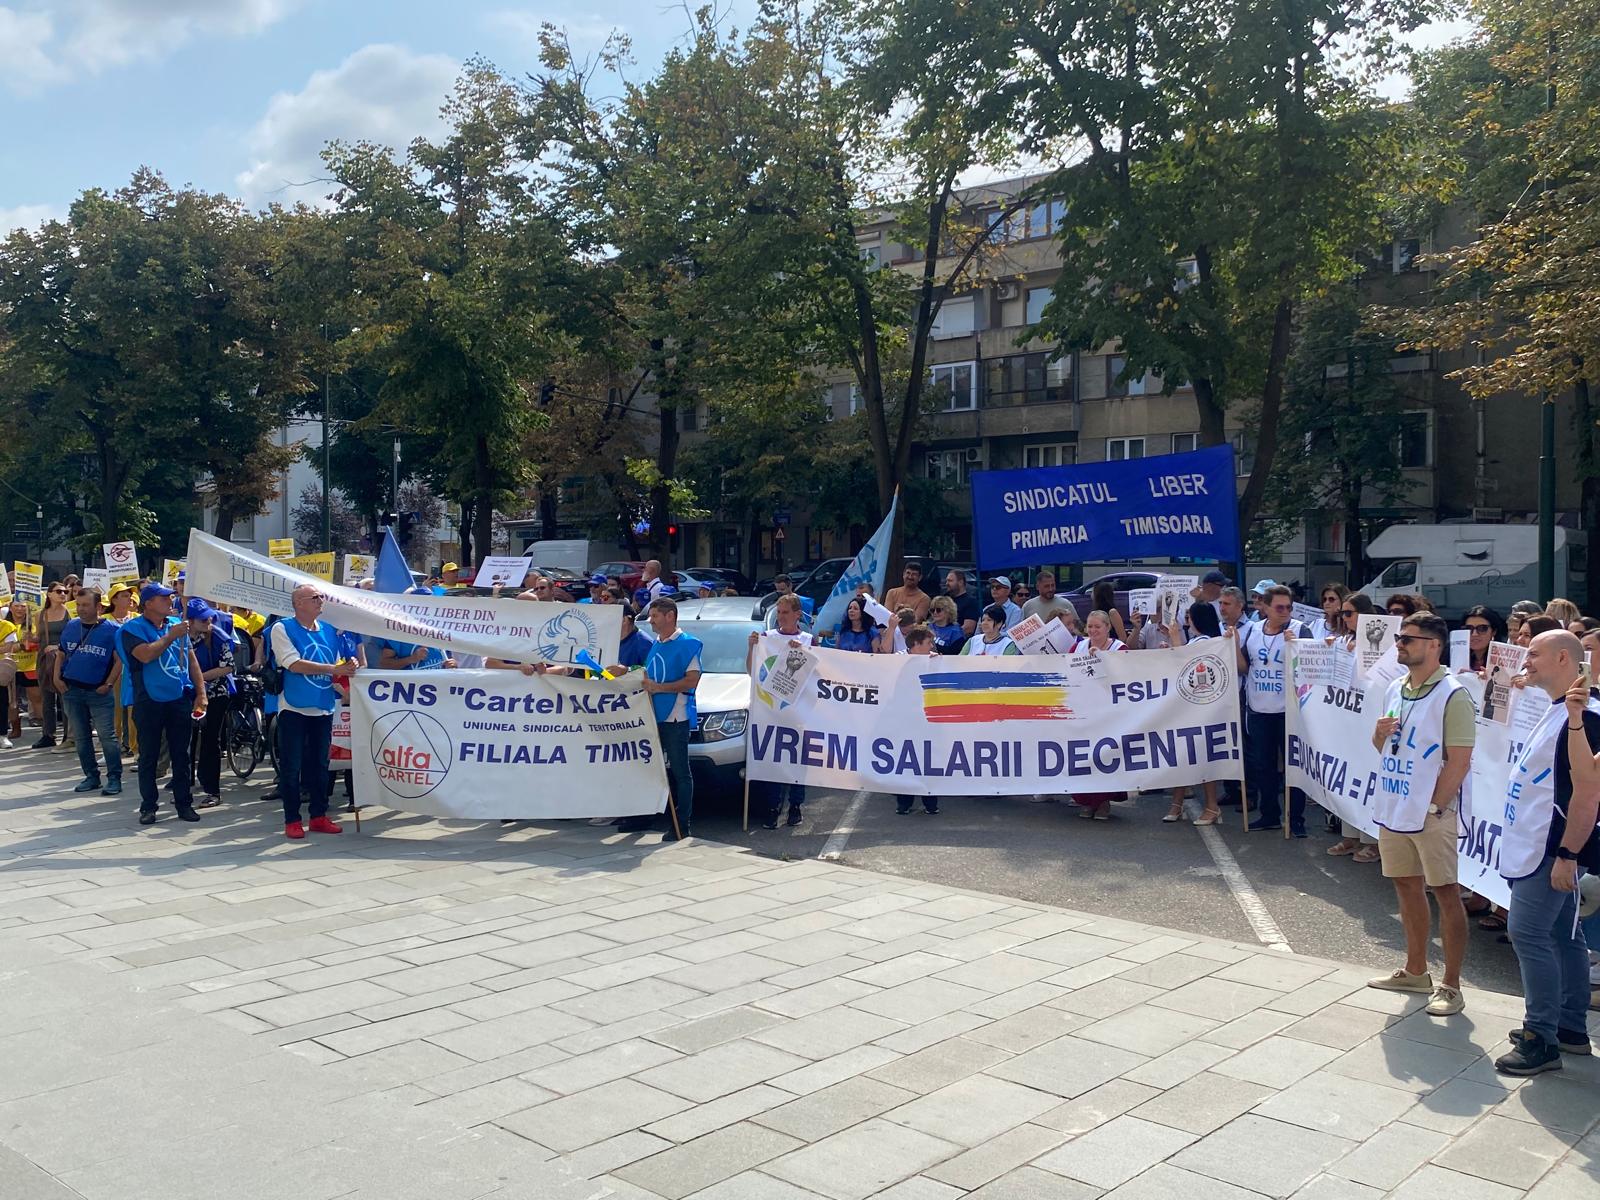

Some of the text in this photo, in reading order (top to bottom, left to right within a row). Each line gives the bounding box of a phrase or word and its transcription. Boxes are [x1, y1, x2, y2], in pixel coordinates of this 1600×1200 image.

[1003, 473, 1208, 514] SINDICATUL LIBER
[1011, 514, 1213, 550] PRIMARIA TIMISOARA
[358, 597, 497, 622] SINDICATUL LIBER DIN
[509, 626, 533, 638] DIN
[1254, 669, 1283, 680] SOLE
[368, 680, 438, 706] CNS
[817, 678, 879, 705] SOLE
[1111, 678, 1169, 704] FSLI
[1323, 685, 1364, 713] SOLE
[463, 721, 516, 732] UNIUNEA
[383, 745, 431, 769] alfa
[459, 742, 567, 765] FILIALA
[751, 721, 1240, 778] VREM SALARII DECENTE!
[379, 766, 434, 786] CARTEL
[1382, 756, 1414, 775] SOLE
